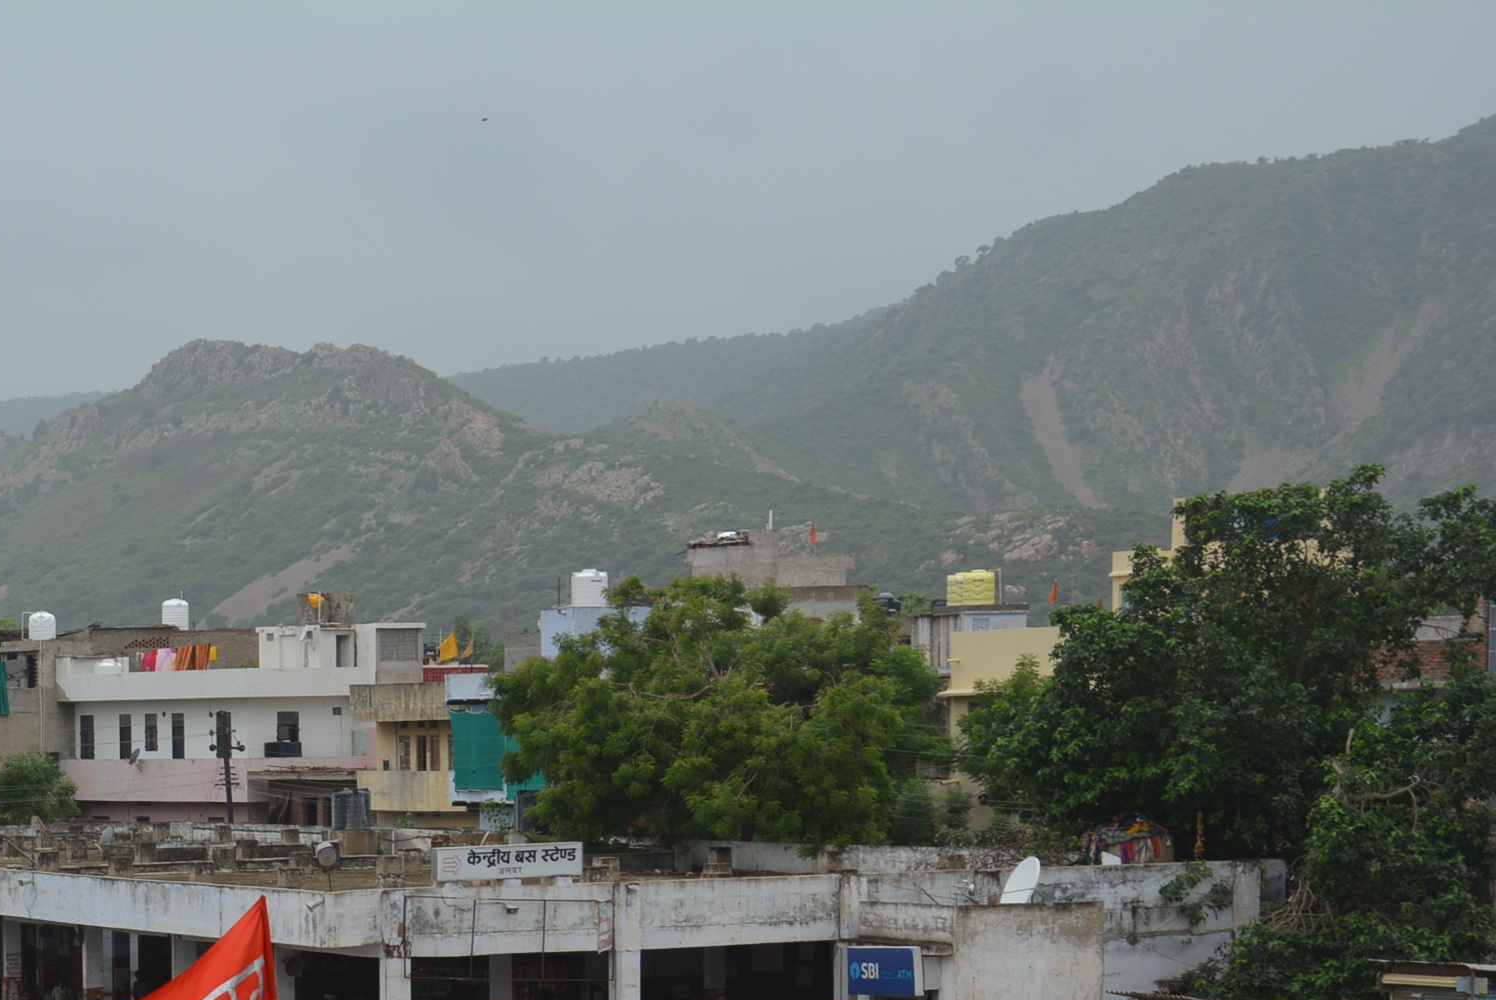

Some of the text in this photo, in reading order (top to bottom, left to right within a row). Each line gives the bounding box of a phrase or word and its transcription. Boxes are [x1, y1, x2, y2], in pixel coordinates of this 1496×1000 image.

[467, 848, 511, 868] केन्द्रीय
[515, 850, 537, 864] बस
[498, 866, 523, 875] अलवर
[861, 962, 879, 980] SBI
[897, 970, 913, 980] ATM
